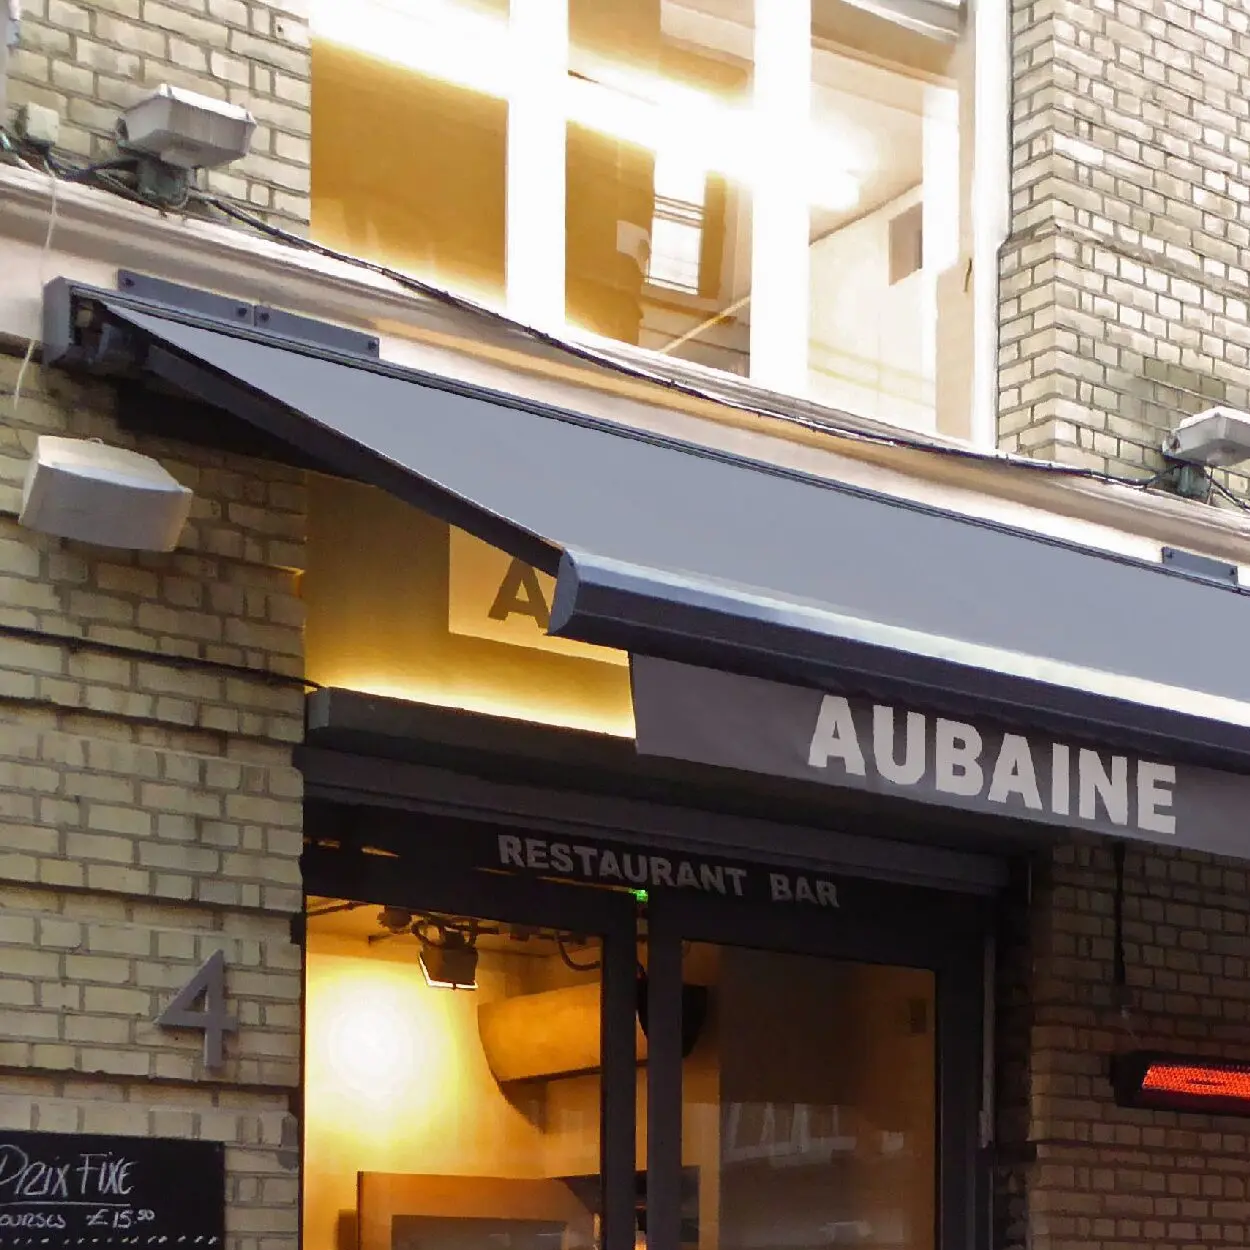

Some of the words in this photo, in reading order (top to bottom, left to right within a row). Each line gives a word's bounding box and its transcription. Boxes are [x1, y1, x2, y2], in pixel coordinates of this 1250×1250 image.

[808, 694, 1176, 834] AUBAINE
[498, 834, 747, 897] RESTAURANT
[770, 873, 840, 908] BAR
[154, 948, 239, 1068] 4
